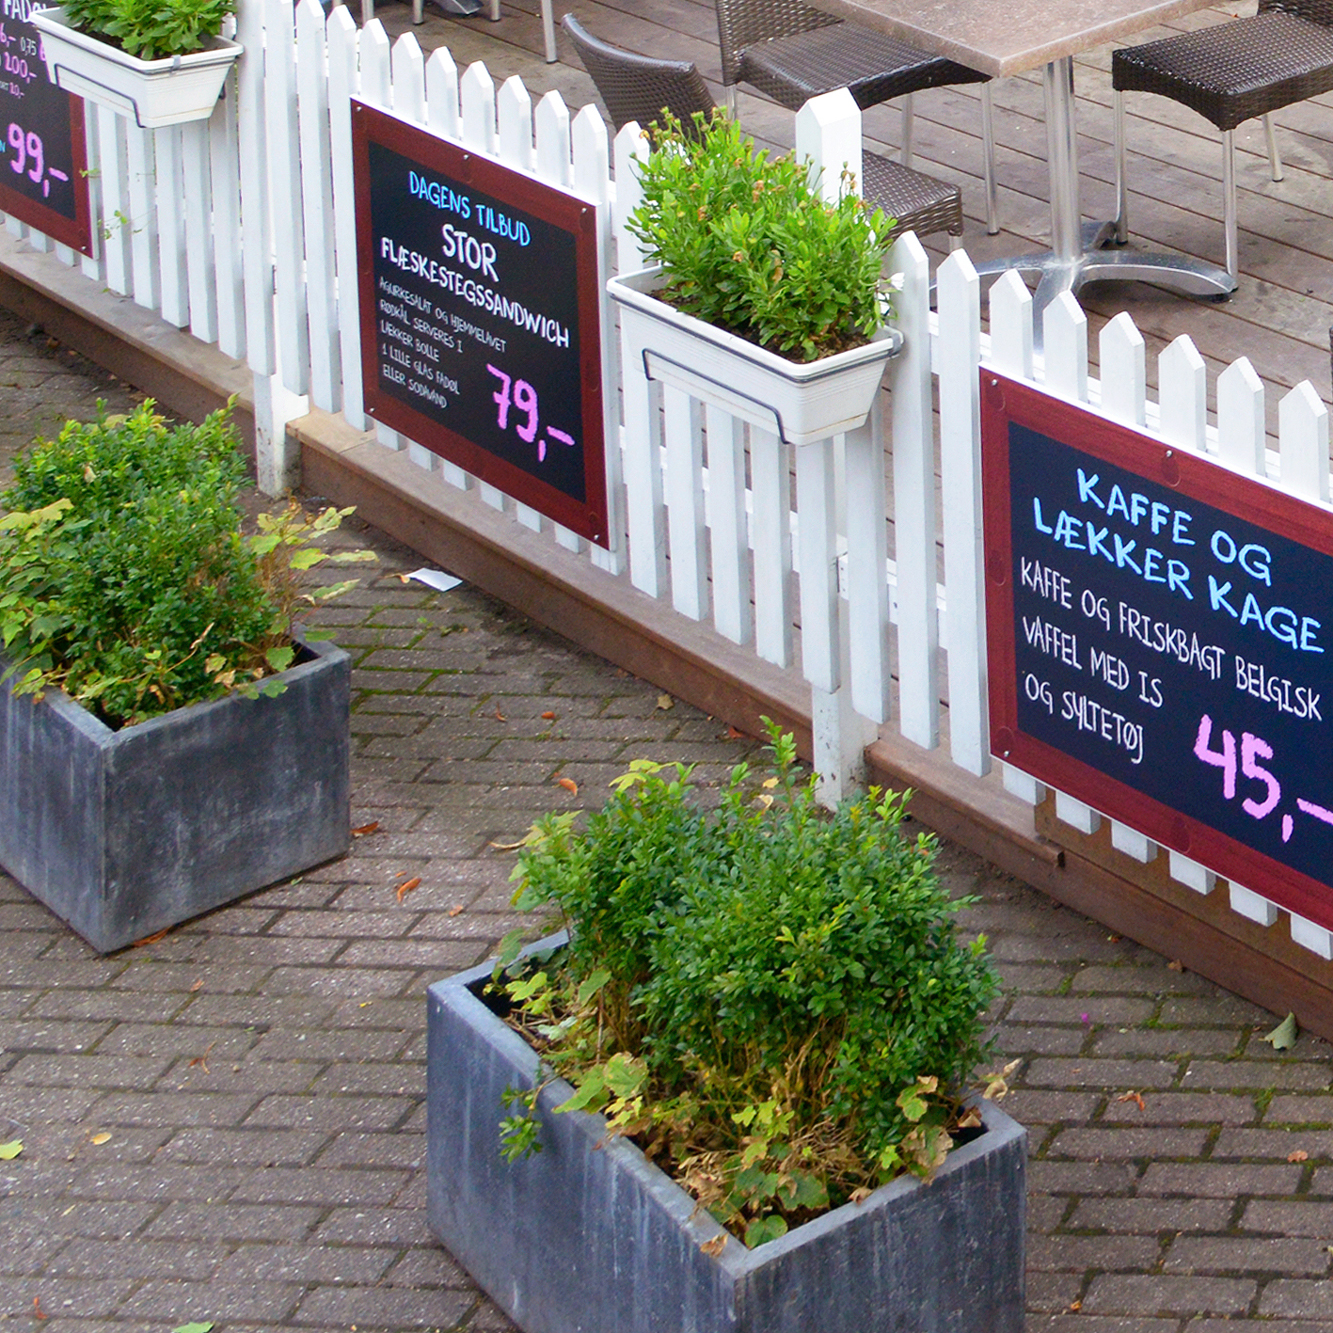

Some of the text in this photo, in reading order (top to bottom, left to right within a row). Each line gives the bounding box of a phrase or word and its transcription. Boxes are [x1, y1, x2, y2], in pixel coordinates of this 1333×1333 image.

[8, 123, 69, 198] 99,-
[410, 171, 531, 246] DAGENS TILBUD
[442, 223, 500, 282] STOR
[381, 237, 570, 348] FLÆSKESTEGSSANDWICH
[413, 317, 455, 348] SERVERES
[435, 307, 449, 325] OG
[383, 364, 406, 385] ELLER
[487, 363, 575, 462] 79,-
[1076, 468, 1272, 586] KAFFE OG
[1033, 497, 1325, 653] LÆKKER KAGE
[1021, 556, 1323, 721] KAFFE OG FRISKBAGT BELGISK
[1022, 616, 1164, 708] VAFFEL MED IS
[1025, 673, 1145, 764] OG SYLTETØJ
